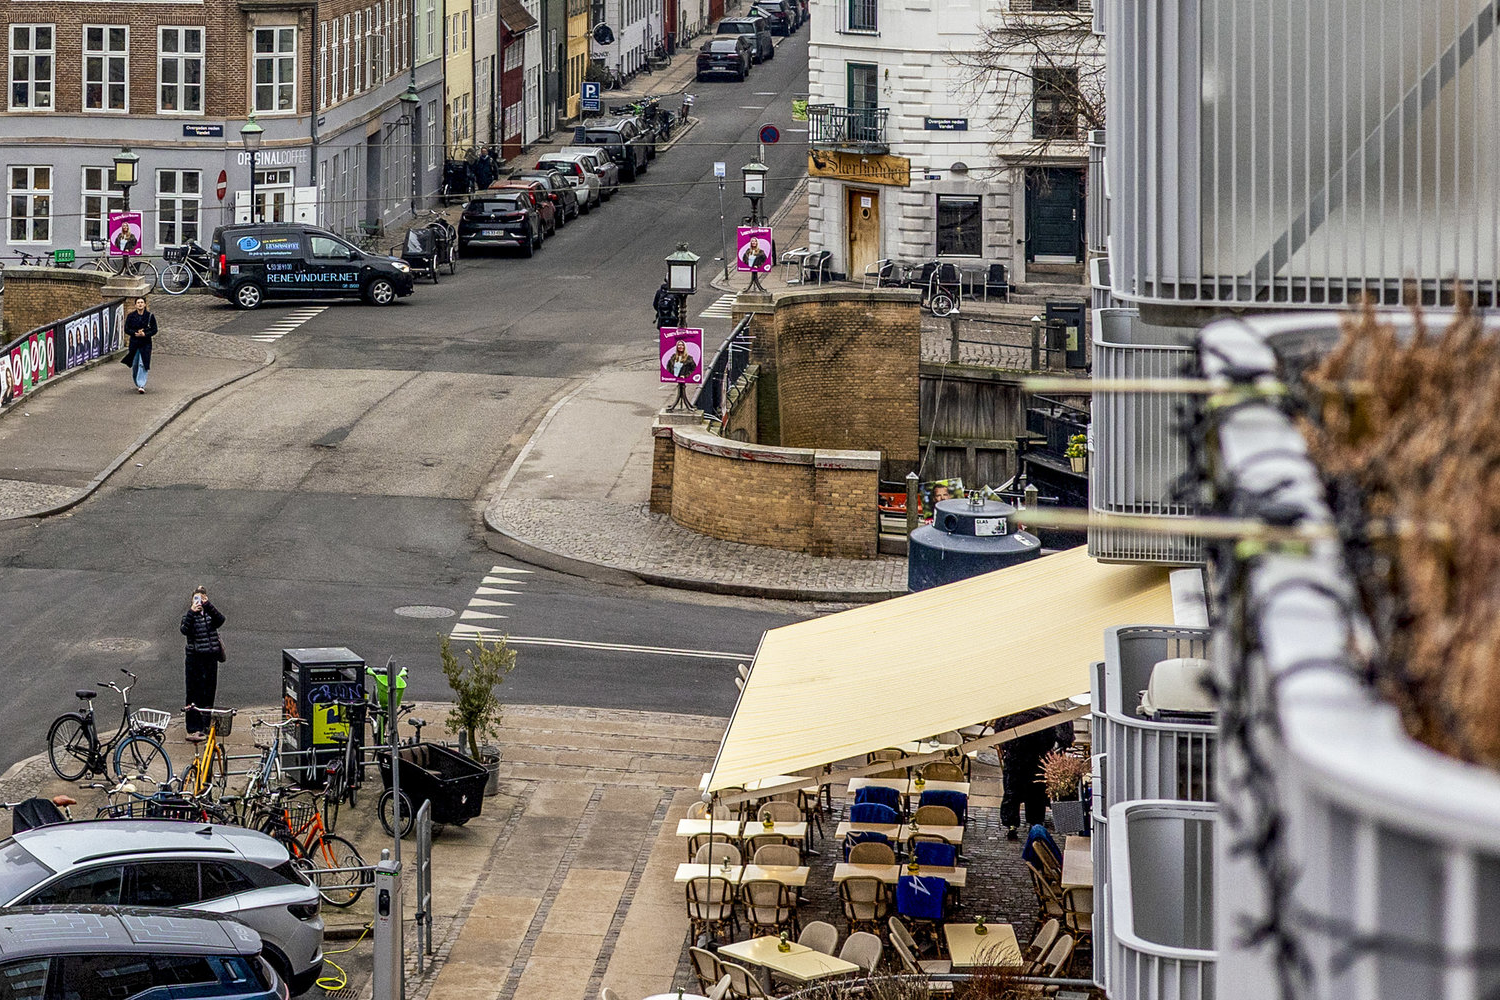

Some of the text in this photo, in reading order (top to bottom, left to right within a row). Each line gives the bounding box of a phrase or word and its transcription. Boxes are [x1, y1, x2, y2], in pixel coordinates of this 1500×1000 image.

[586, 84, 597, 98] P
[268, 173, 276, 181] 41
[266, 272, 359, 283] RENEVINDUER.NET
